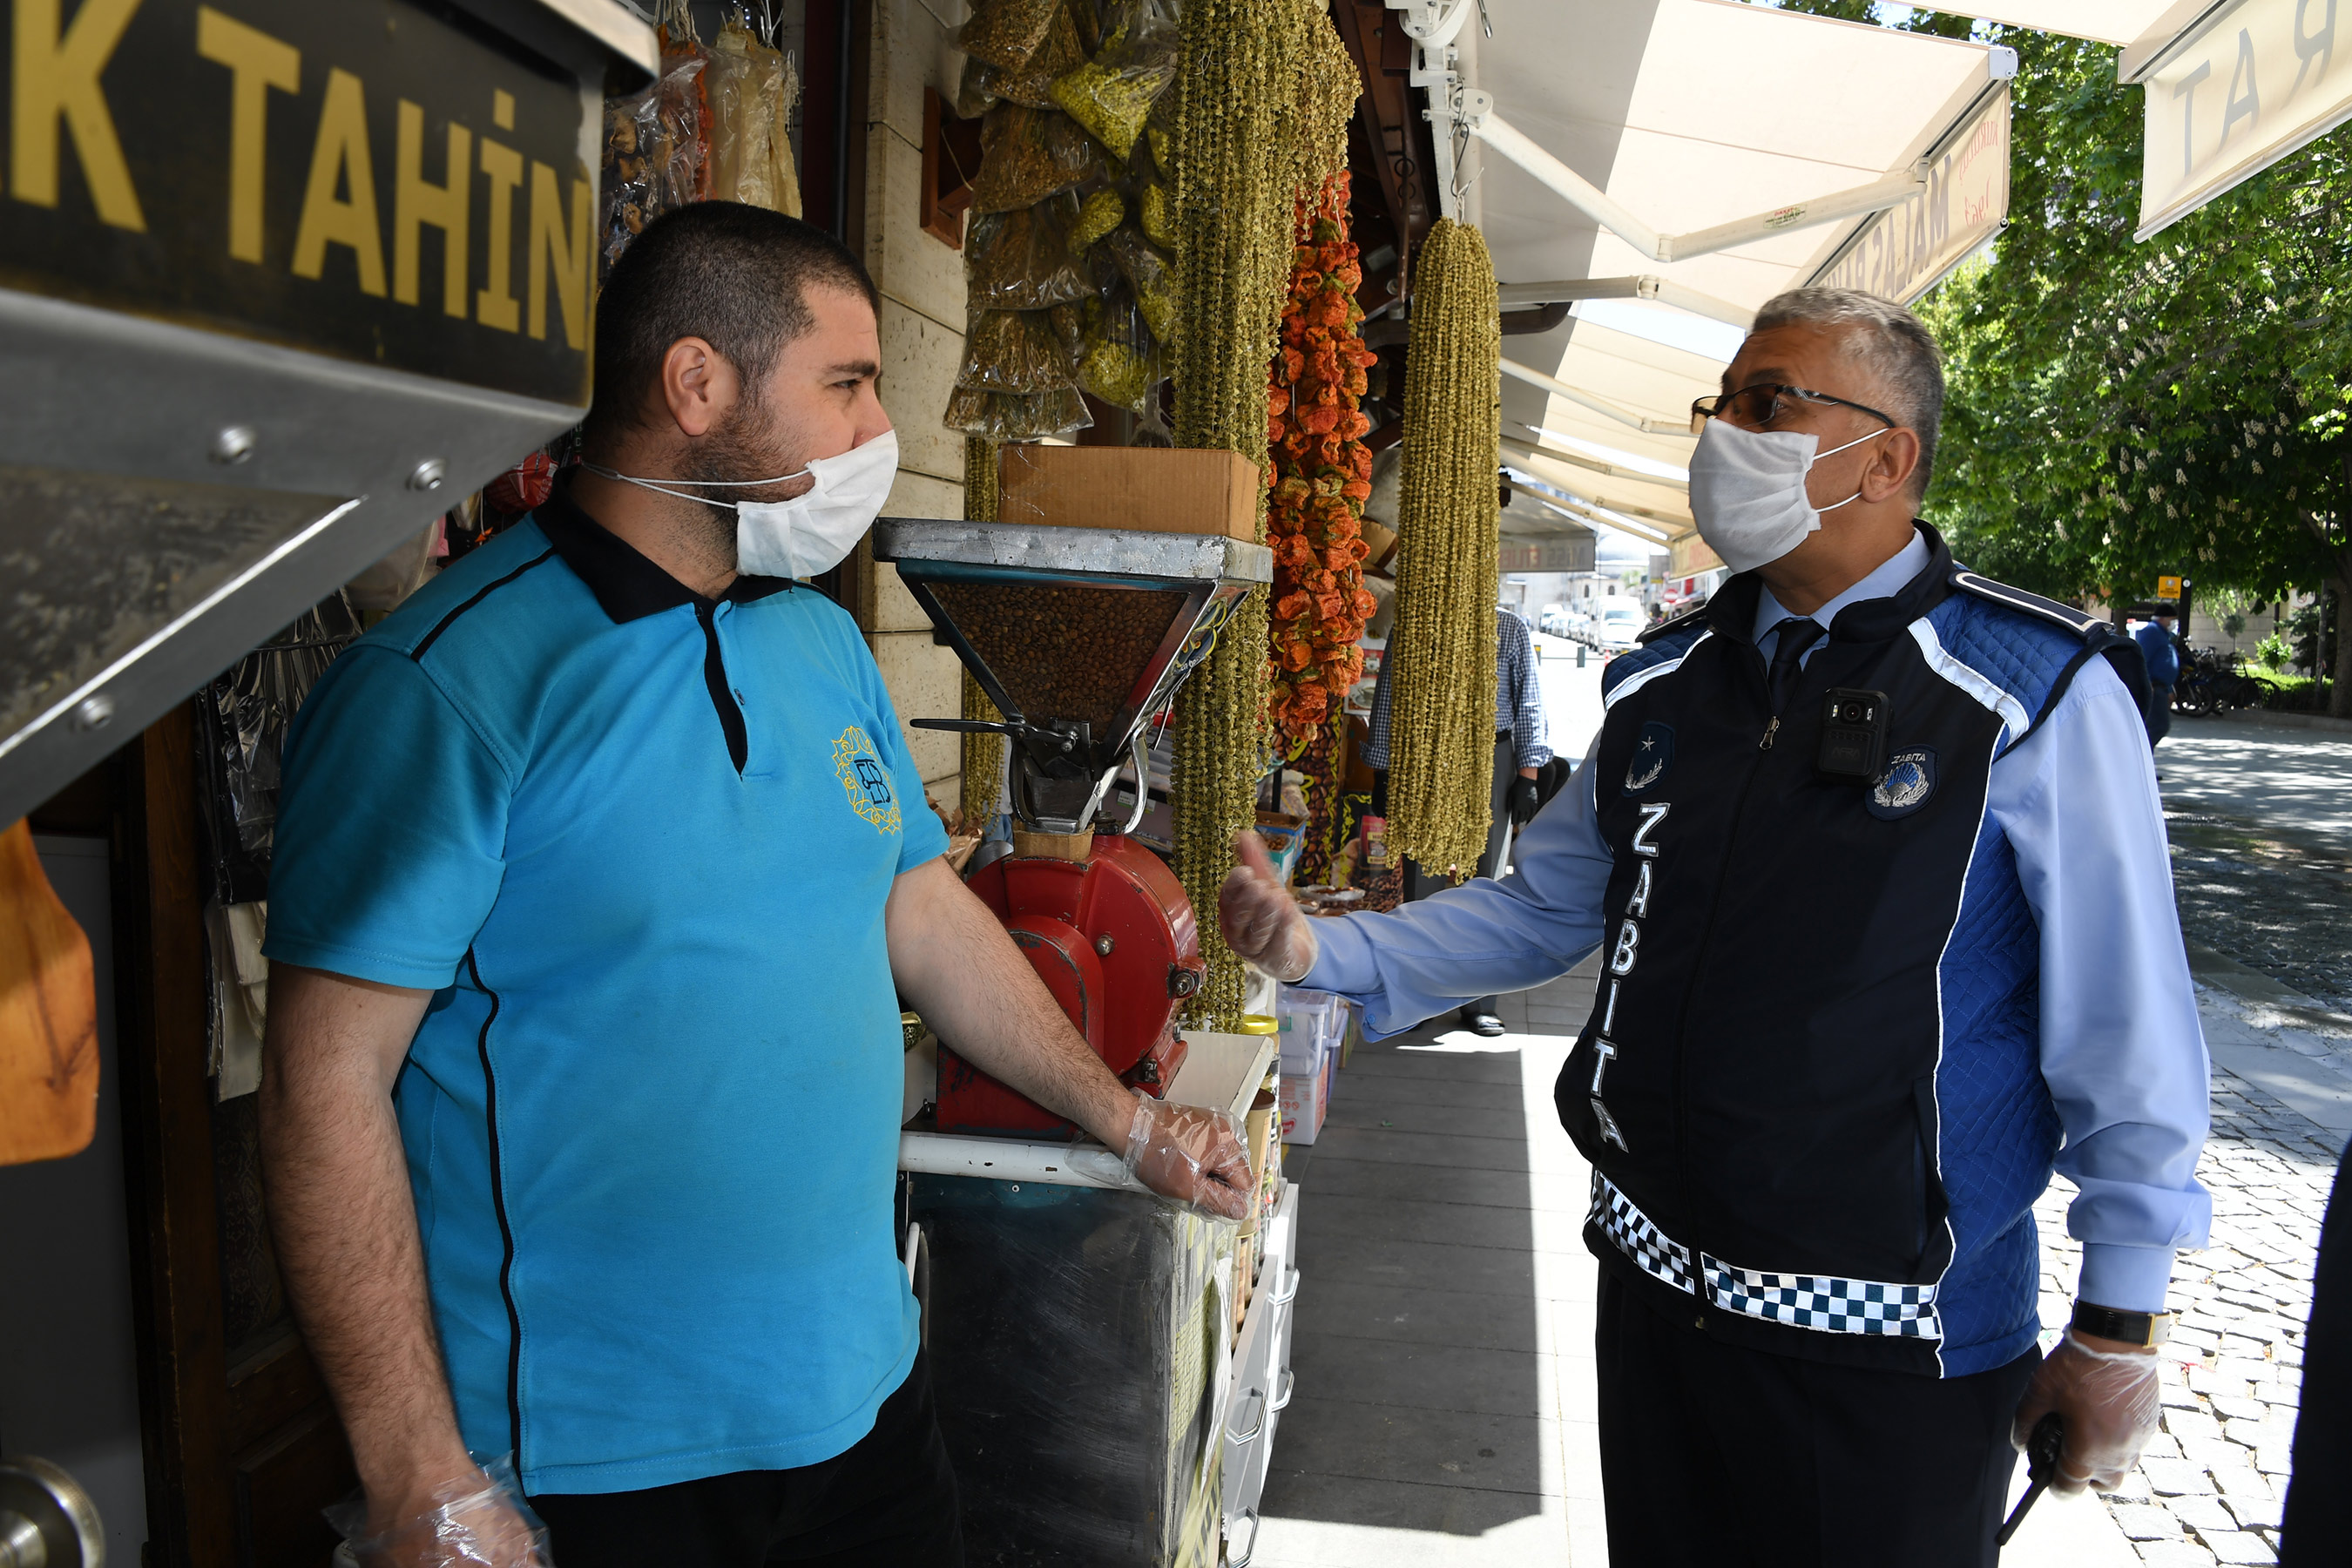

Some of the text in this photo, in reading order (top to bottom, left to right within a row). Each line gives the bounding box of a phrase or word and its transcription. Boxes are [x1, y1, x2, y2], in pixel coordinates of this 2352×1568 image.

[197, 4, 592, 351] TAHİN
[1890, 753, 1926, 765] ZABITA
[1591, 802, 1672, 1154] ZABITA
